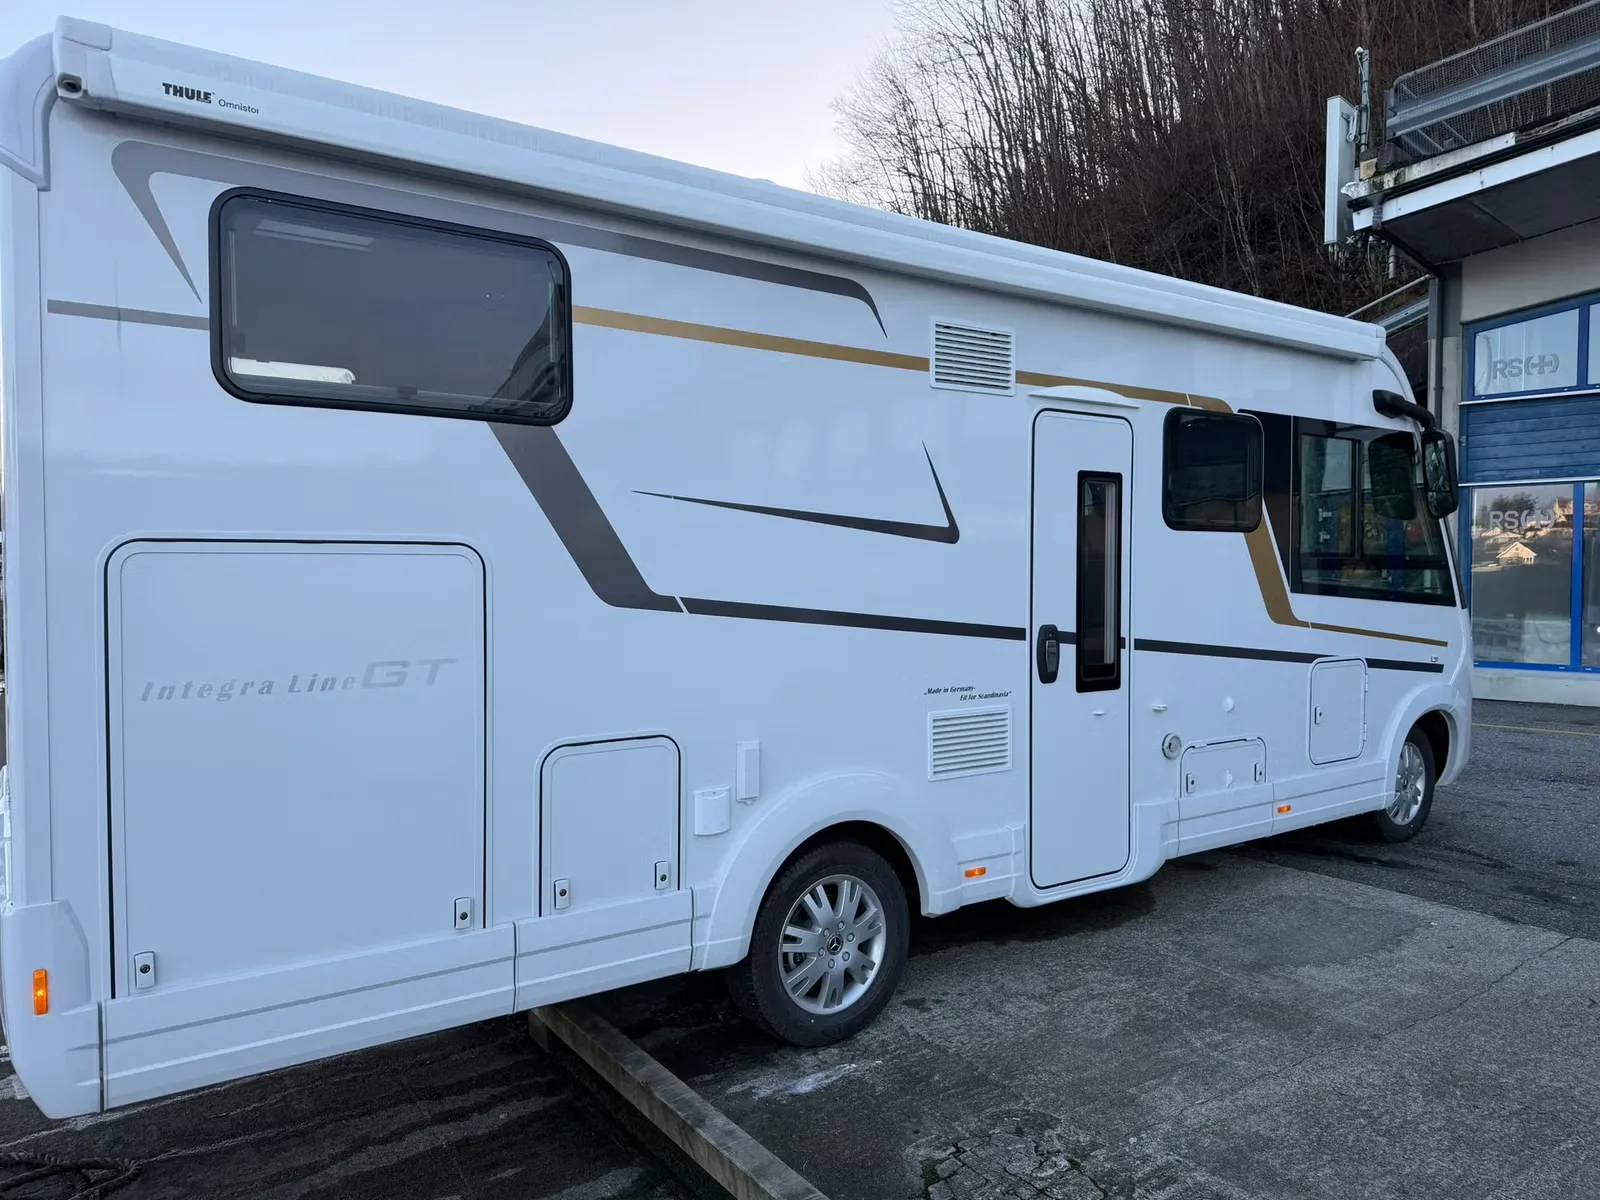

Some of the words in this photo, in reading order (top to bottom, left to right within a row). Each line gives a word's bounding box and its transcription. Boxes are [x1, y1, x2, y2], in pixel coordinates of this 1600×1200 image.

[162, 82, 212, 104] THULE
[140, 680, 275, 702] Integra
[287, 673, 357, 694] Line
[361, 657, 459, 689] GT
